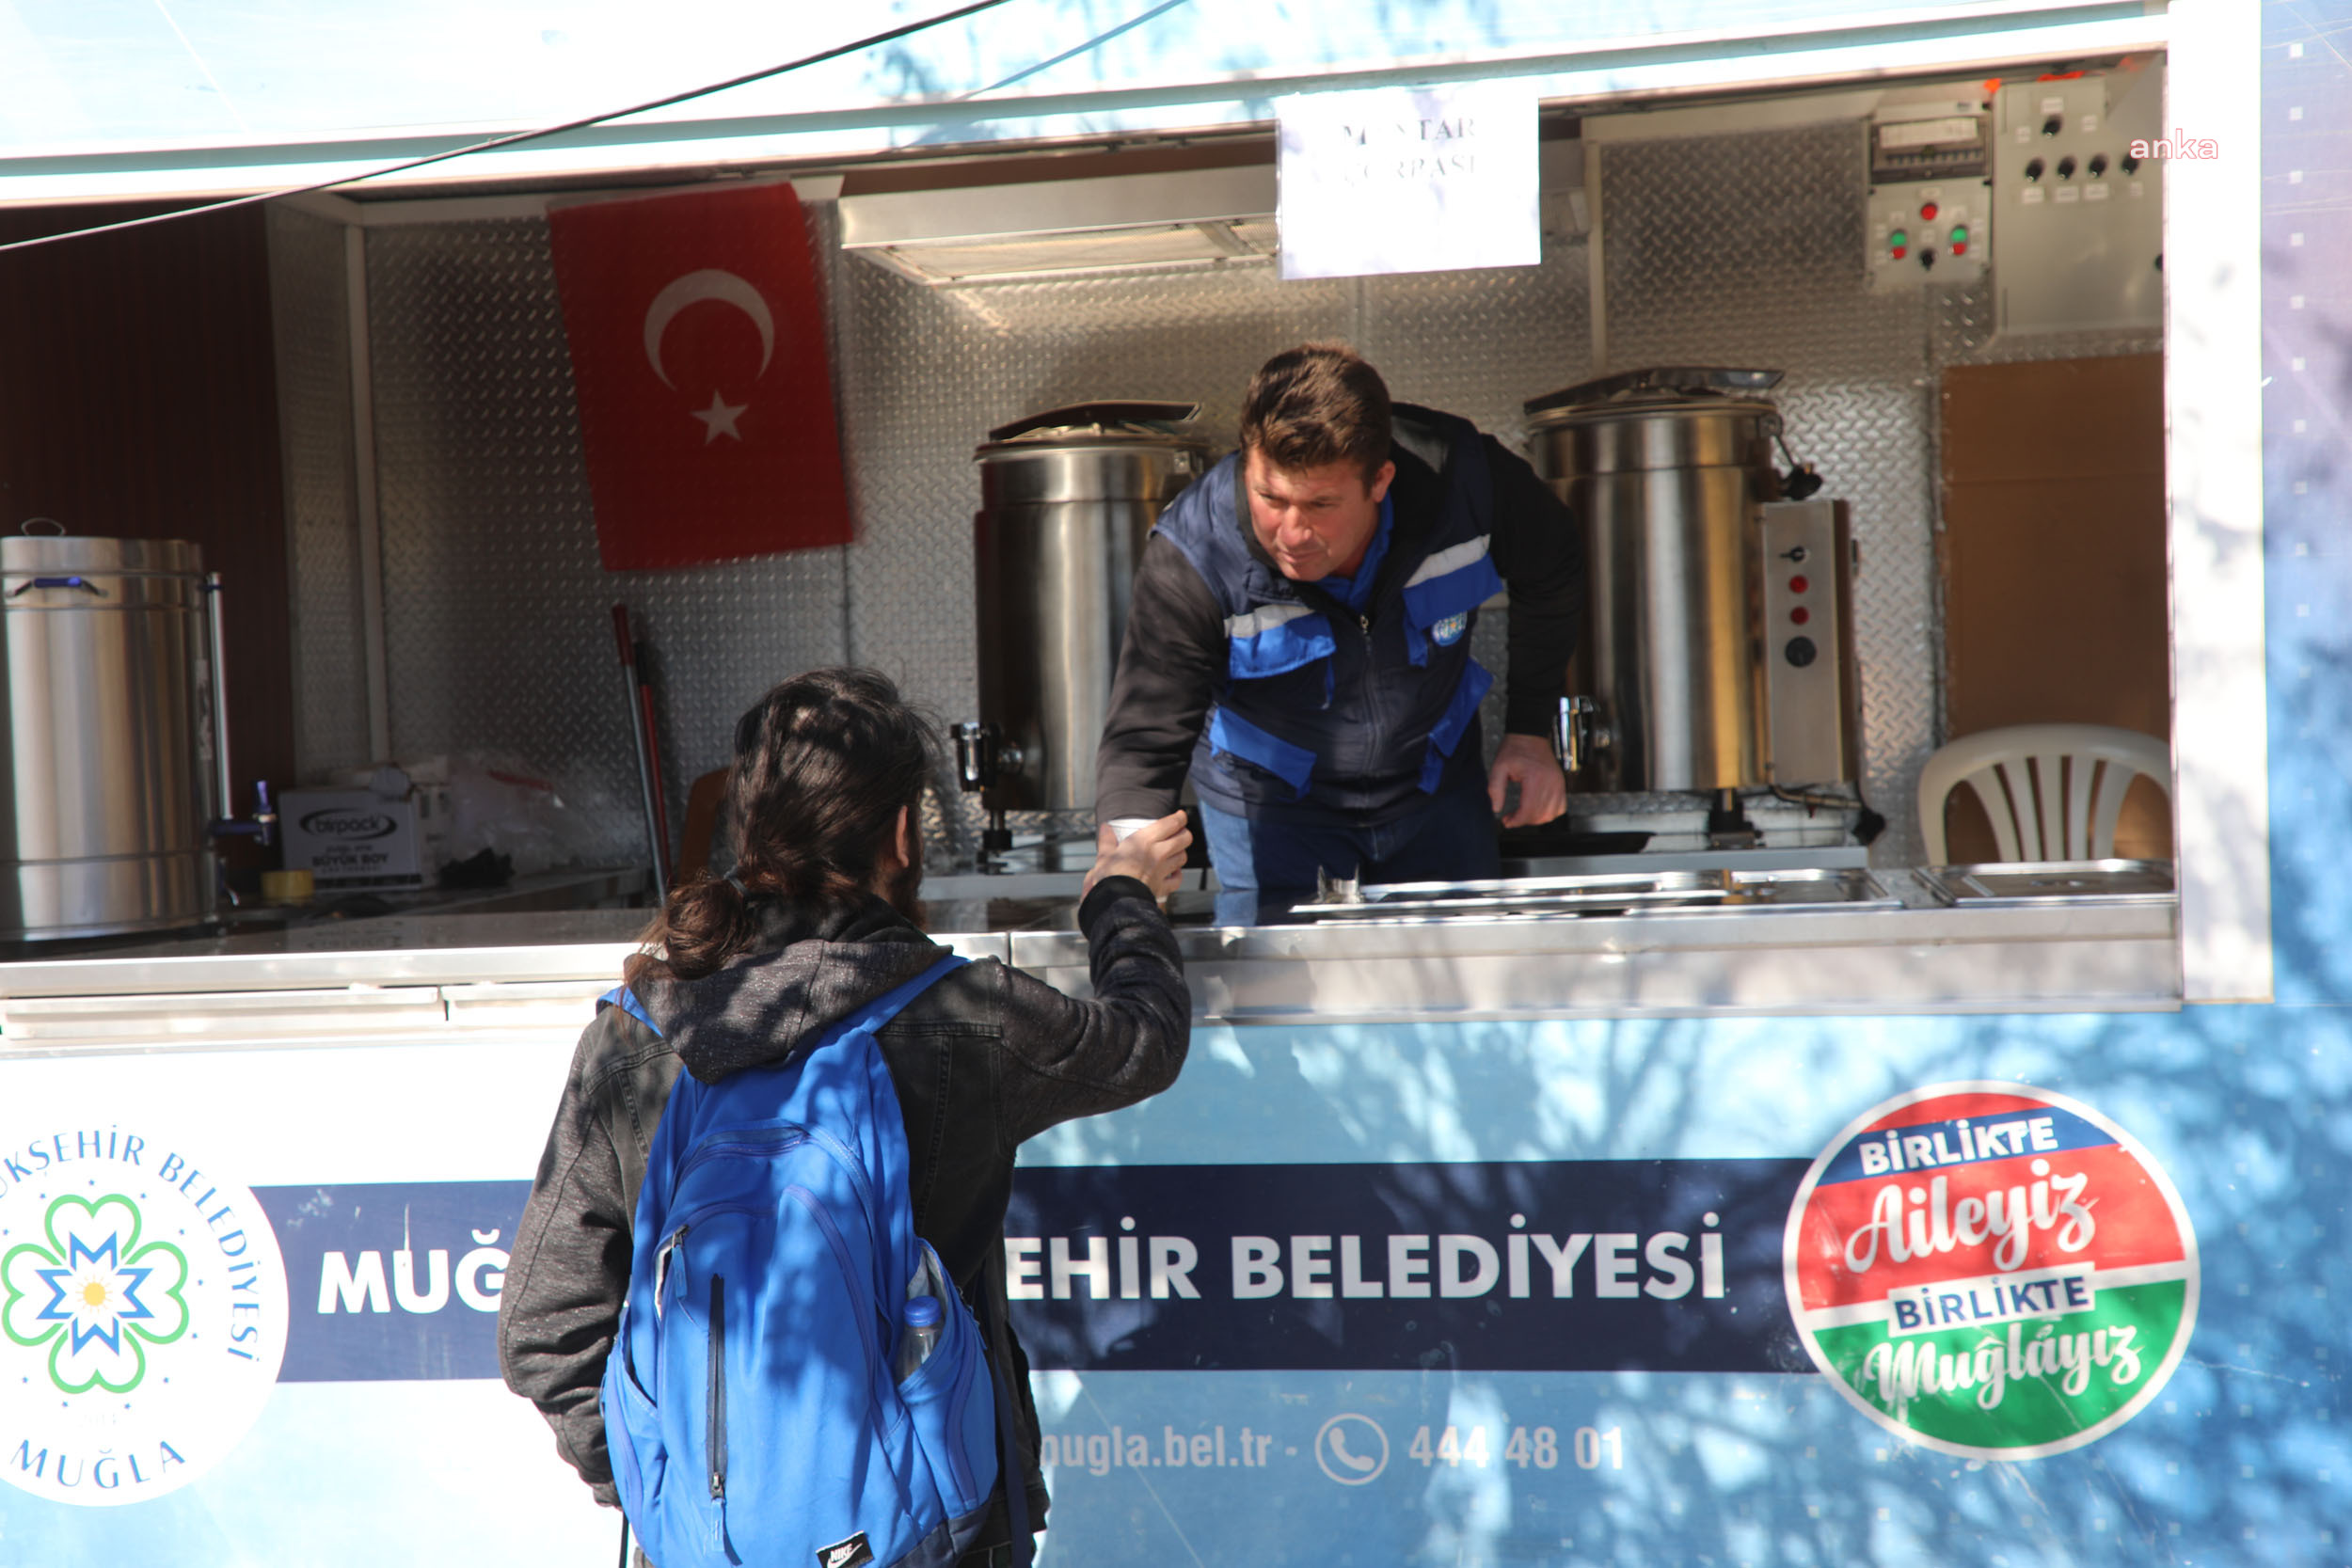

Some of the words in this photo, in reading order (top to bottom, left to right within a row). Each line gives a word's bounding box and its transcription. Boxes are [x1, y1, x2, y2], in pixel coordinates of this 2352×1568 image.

[1343, 118, 1475, 146] MTAR
[1858, 1117, 2059, 1177] BİRLİKTE
[1844, 1159, 2101, 1273] Aileyiz
[158, 1151, 262, 1363] BELEDİYESİ
[317, 1227, 512, 1314] MUĞ
[1004, 1215, 1202, 1301] EHİR
[1231, 1211, 1726, 1300] BELEDİYESİ
[1893, 1275, 2090, 1331] BİRLİKTE
[9, 1438, 187, 1489] MUĞLA
[1408, 1425, 1490, 1470] 444
[1505, 1425, 1559, 1470] 48
[1575, 1425, 1625, 1470] 01
[830, 1543, 853, 1562] NIKE
